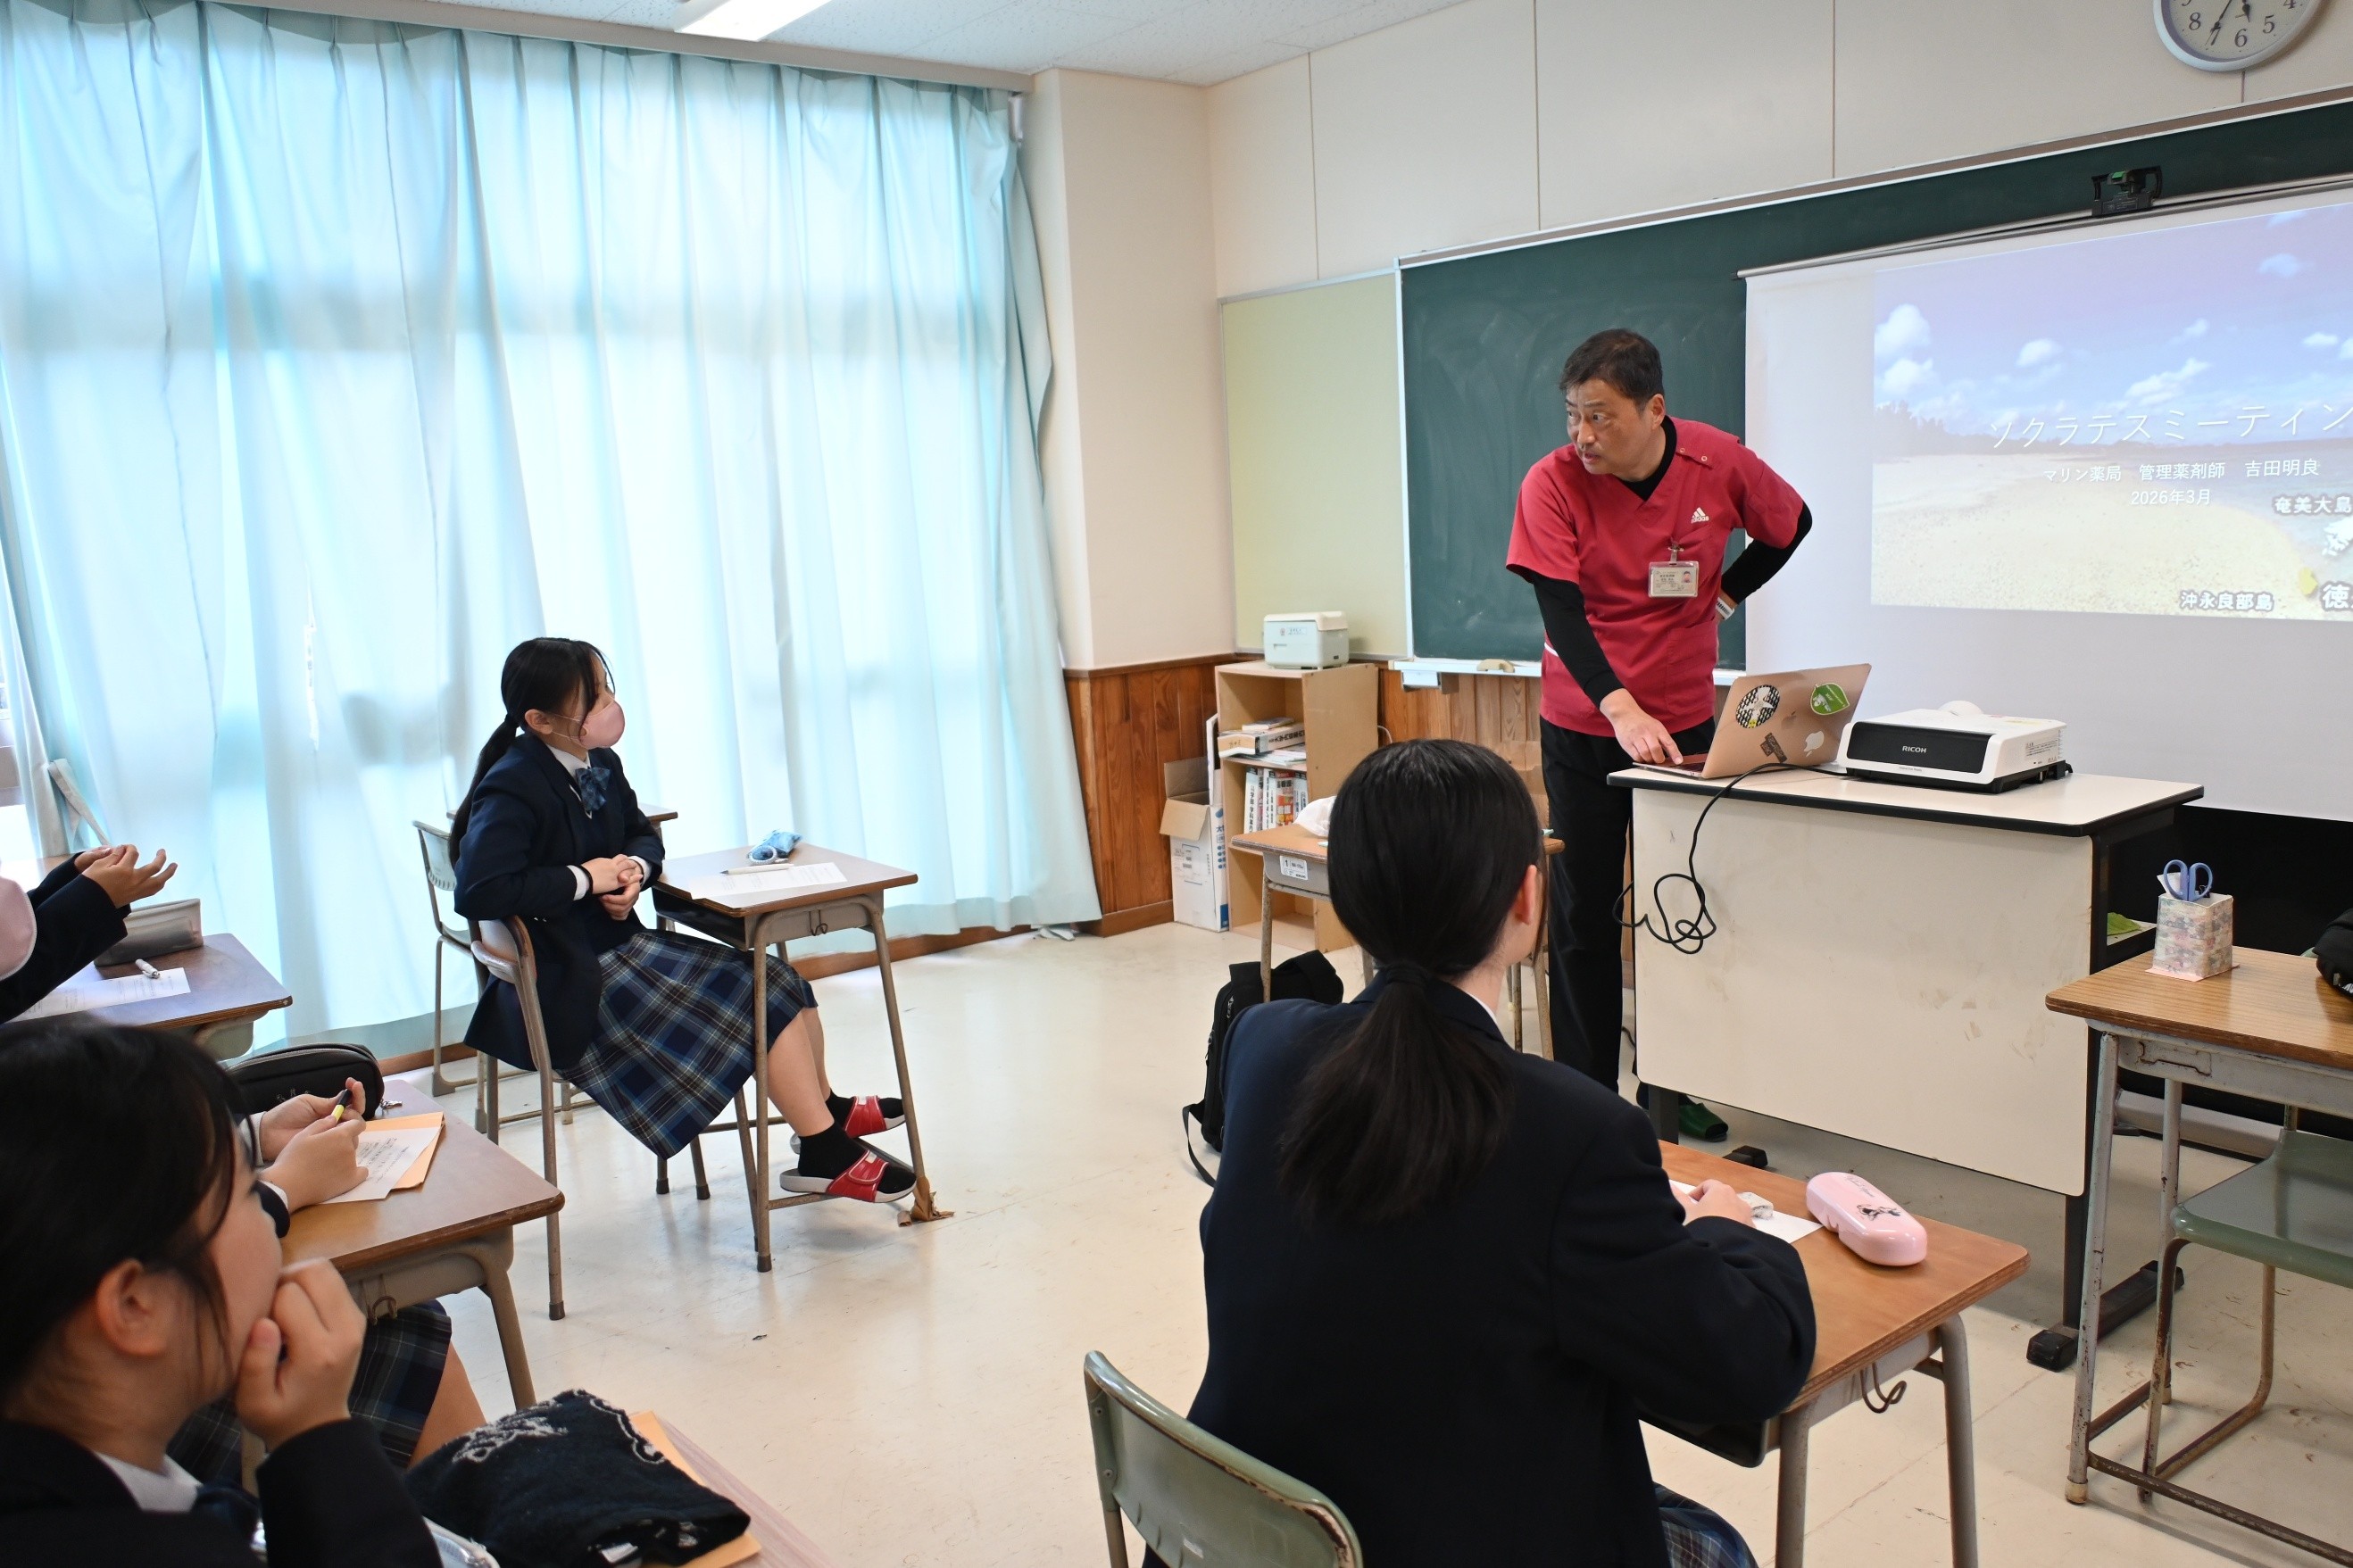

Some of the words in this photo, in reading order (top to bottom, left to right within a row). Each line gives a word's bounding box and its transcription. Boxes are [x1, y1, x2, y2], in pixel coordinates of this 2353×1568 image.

[2189, 12, 2201, 30] 8
[2262, 14, 2275, 34] 5
[2234, 29, 2248, 47] 6
[1991, 404, 2353, 448] ソクラテスミーティン
[2043, 466, 2121, 482] マリン薬局
[2139, 463, 2225, 481] 管理薬剤師
[2245, 459, 2319, 477] 吉田明良
[2130, 489, 2210, 505] 2026年3月
[2274, 496, 2352, 514] 奄美大島
[2181, 591, 2274, 610] 沖永良部島
[2322, 585, 2353, 609] 徳
[1902, 745, 1927, 753] RICOH
